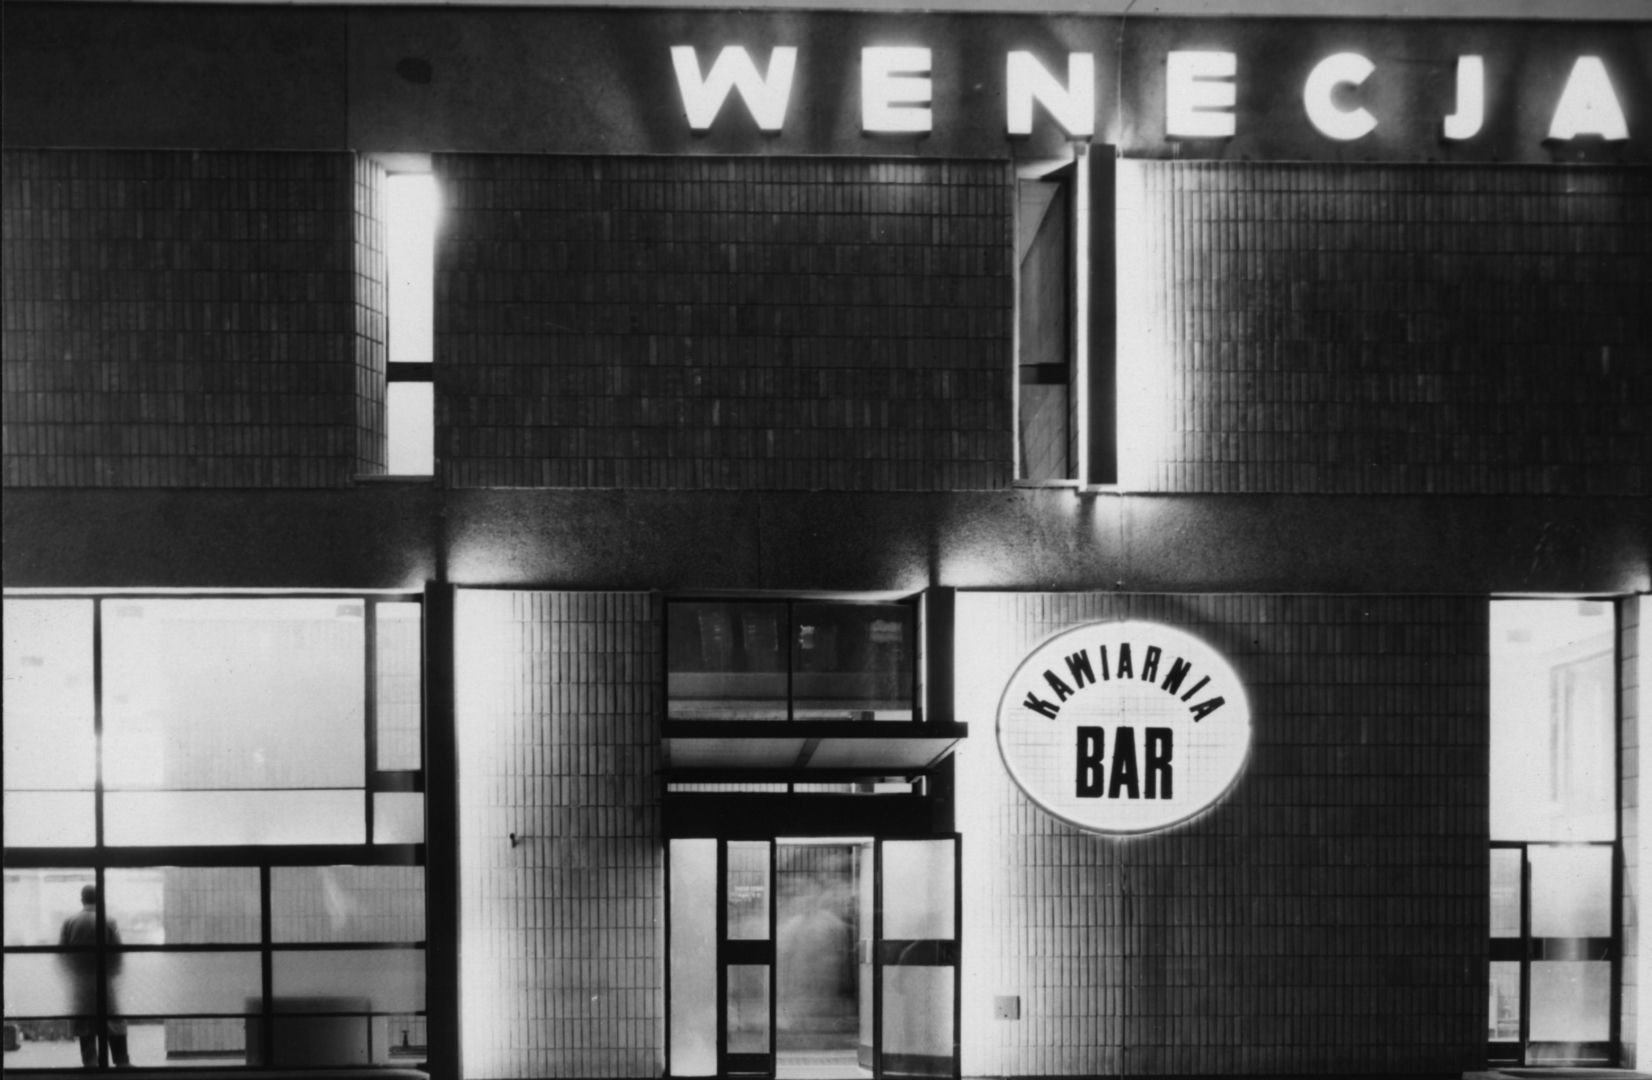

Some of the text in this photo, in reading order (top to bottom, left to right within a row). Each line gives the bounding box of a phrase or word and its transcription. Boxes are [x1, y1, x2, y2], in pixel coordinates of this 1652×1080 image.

[669, 45, 1630, 141] WENECJA
[1023, 642, 1225, 722] KAWIARNIA
[1075, 725, 1173, 800] BAR
